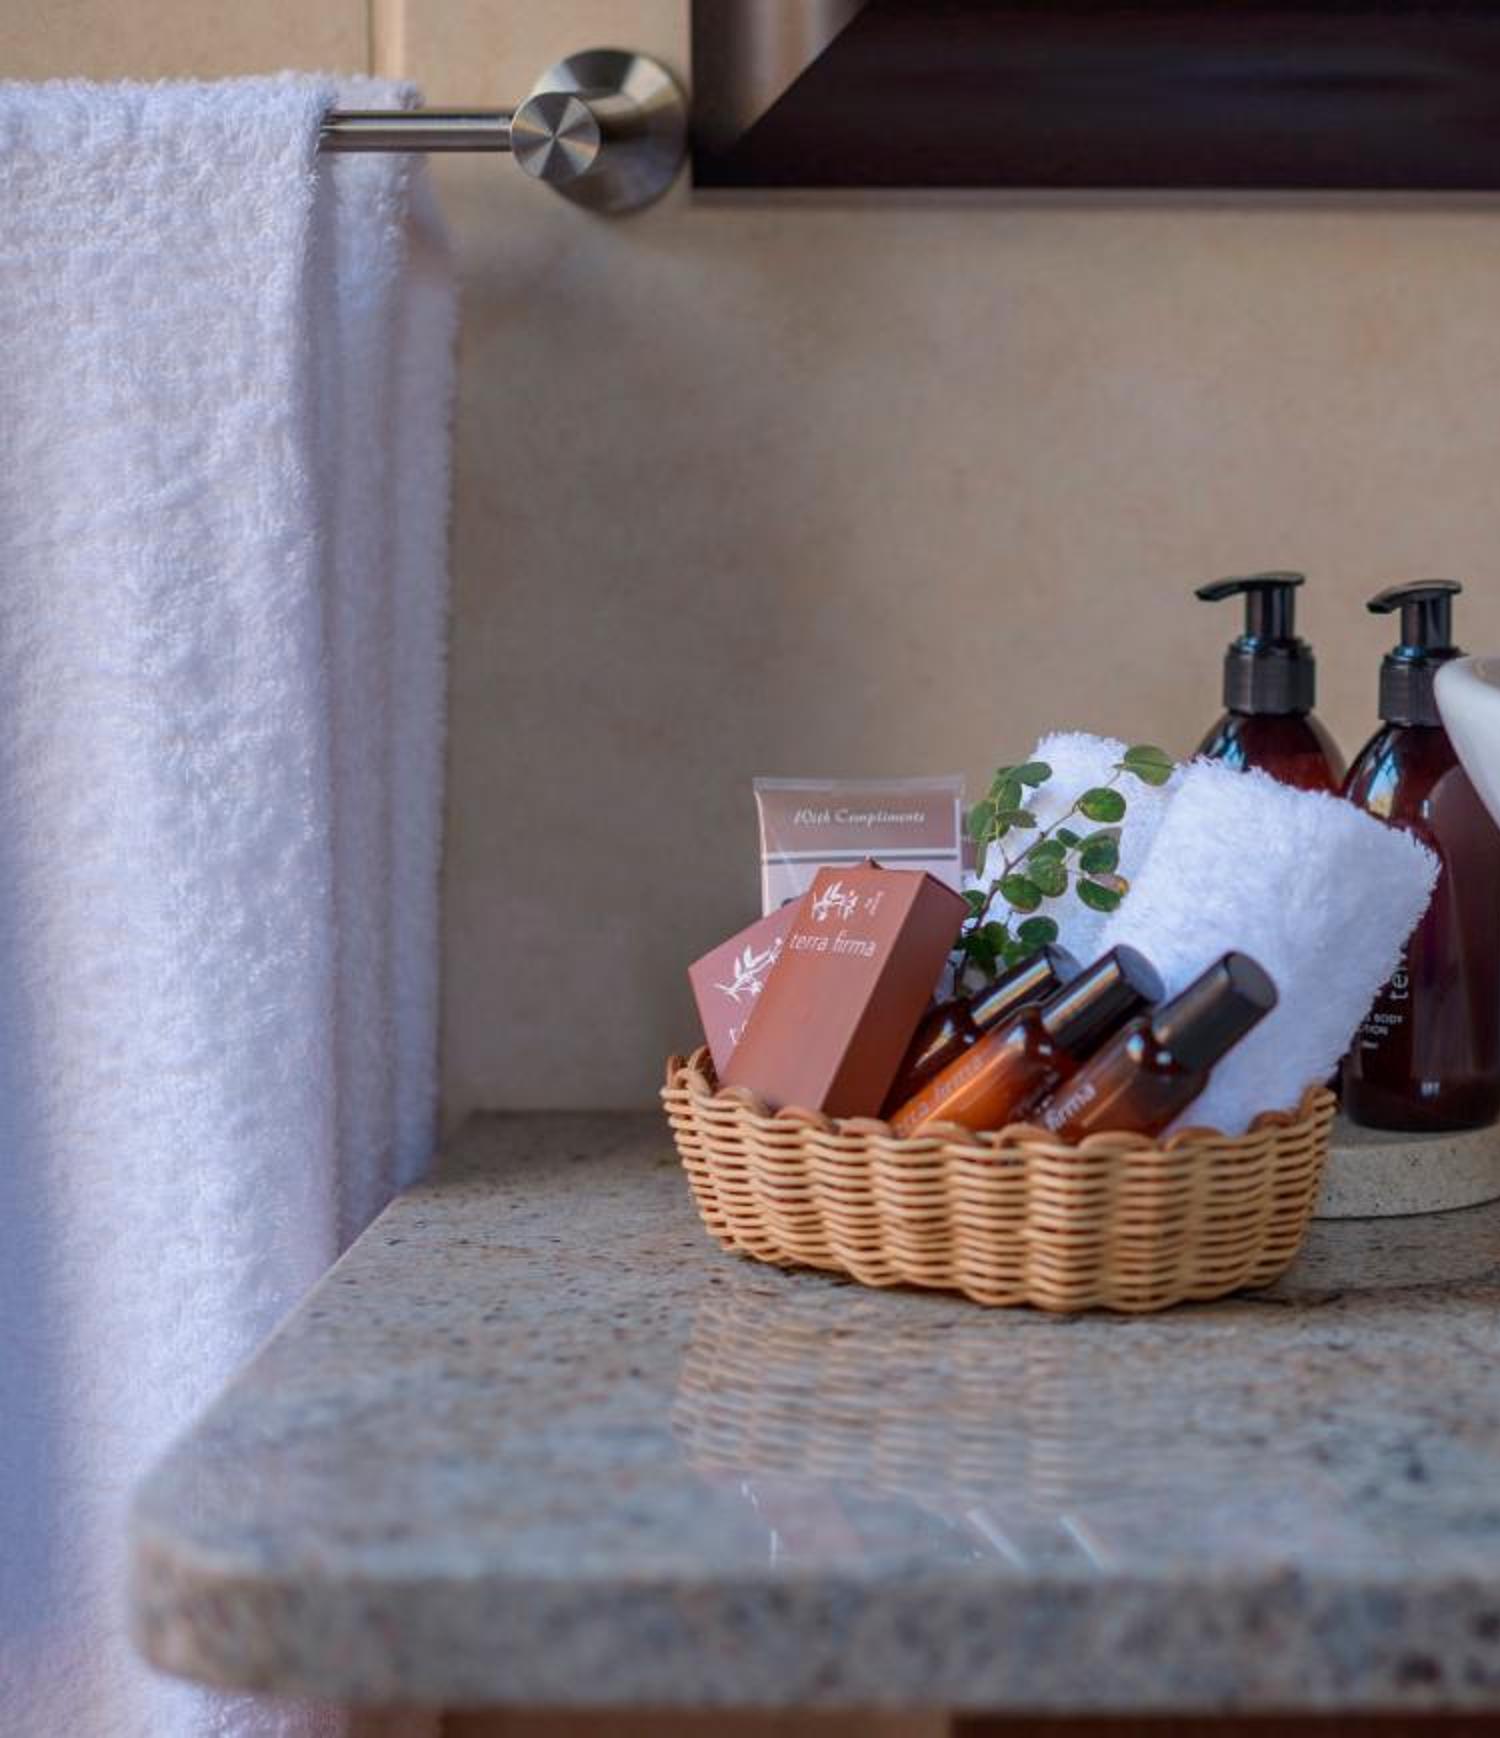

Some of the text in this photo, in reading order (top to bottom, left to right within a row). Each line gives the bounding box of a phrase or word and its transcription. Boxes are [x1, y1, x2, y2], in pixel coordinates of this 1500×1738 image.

[834, 808, 926, 828] Compliments
[788, 929, 877, 958] terra firma
